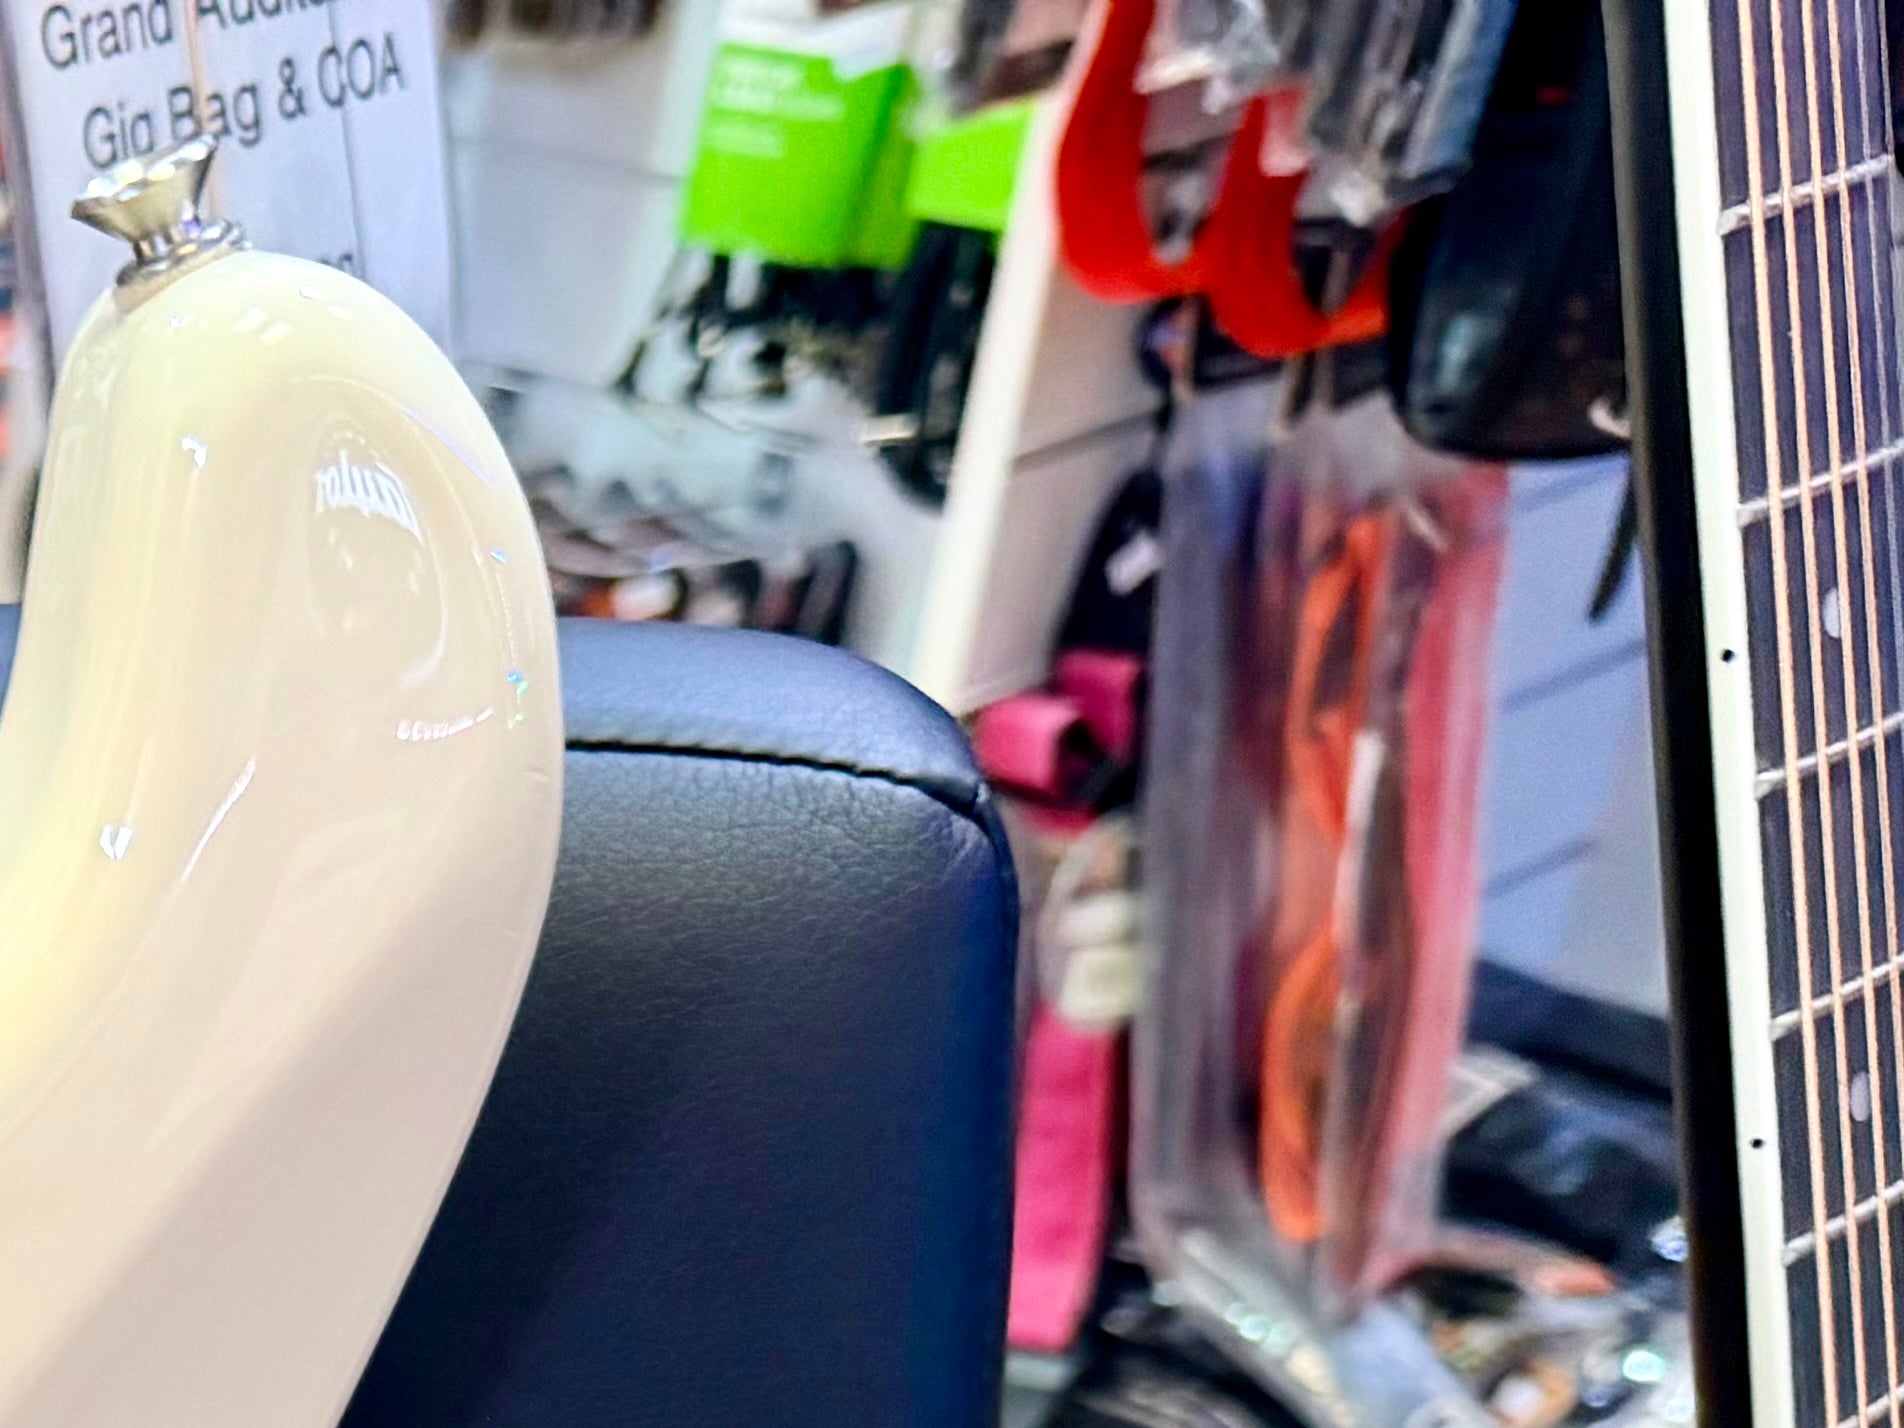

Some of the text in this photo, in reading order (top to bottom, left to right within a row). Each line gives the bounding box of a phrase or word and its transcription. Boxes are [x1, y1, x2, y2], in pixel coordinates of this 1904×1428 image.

[40, 0, 174, 70] Grand
[167, 81, 263, 148] Bag
[278, 56, 306, 120] &
[317, 32, 405, 108] COA
